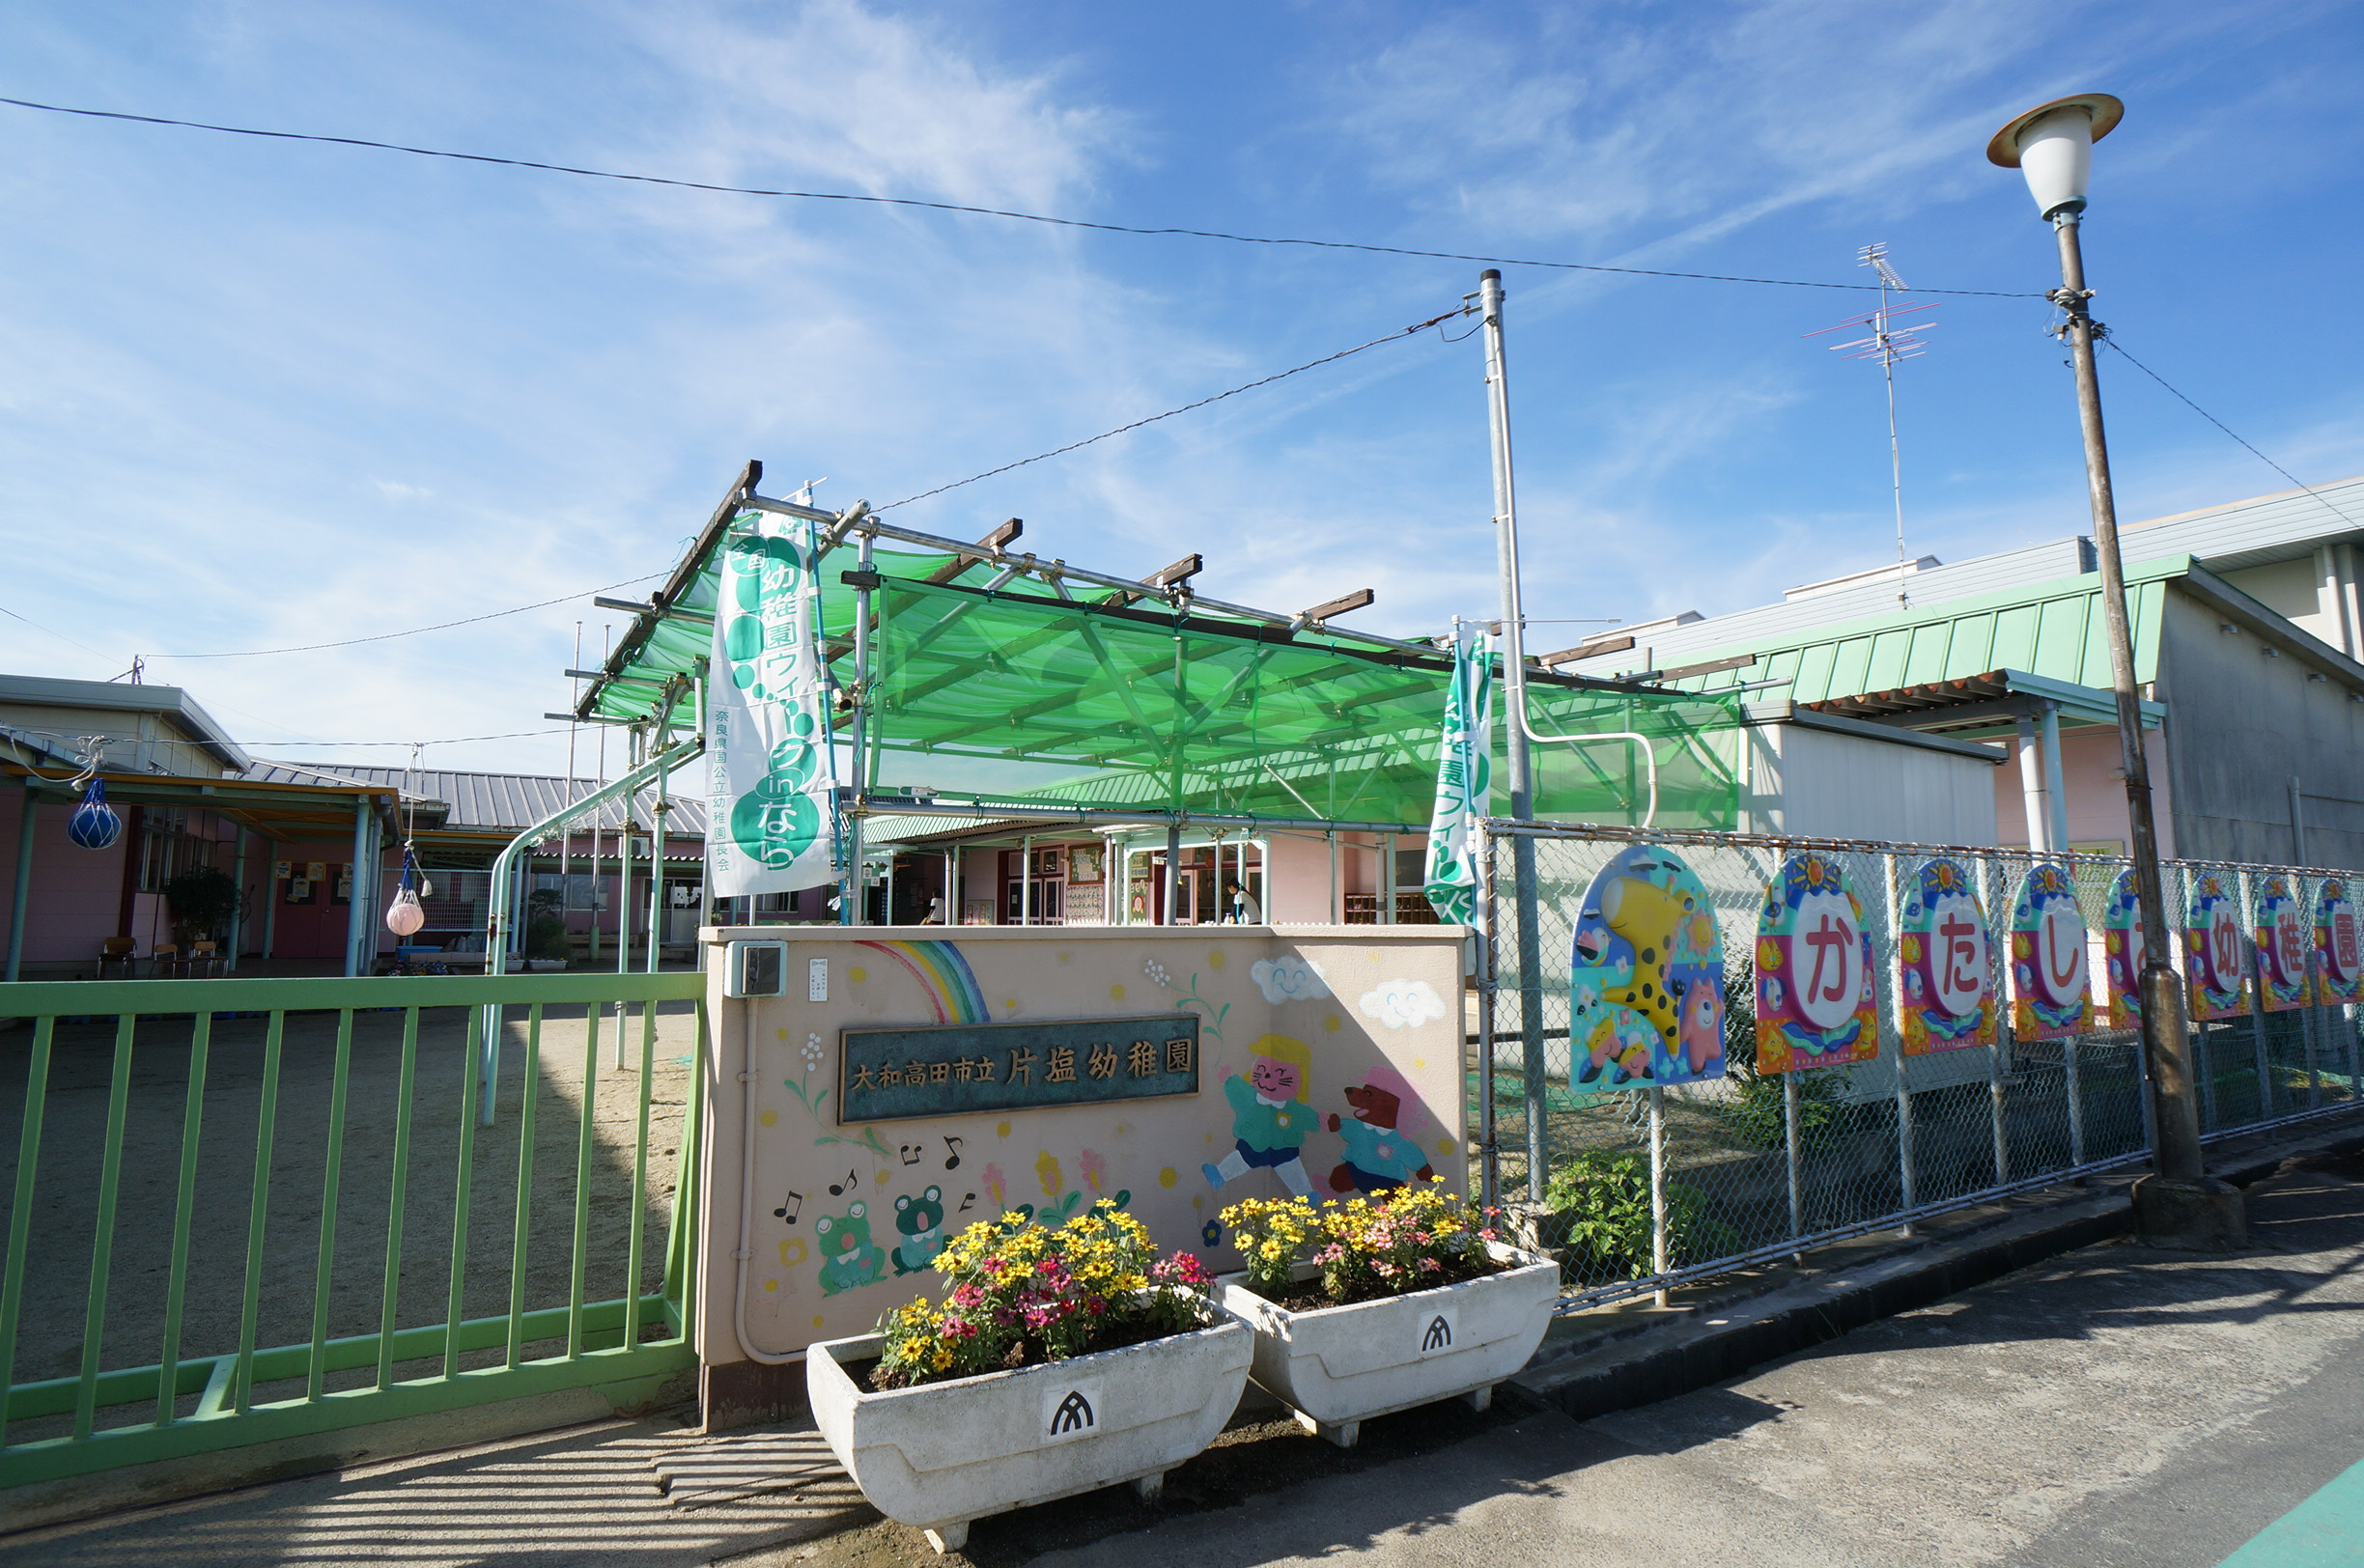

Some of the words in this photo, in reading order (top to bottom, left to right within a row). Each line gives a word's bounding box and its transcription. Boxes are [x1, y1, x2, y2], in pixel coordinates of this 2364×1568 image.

[731, 542, 767, 571] 全国
[713, 710, 730, 873] 奈良県国公立幼稚園長会
